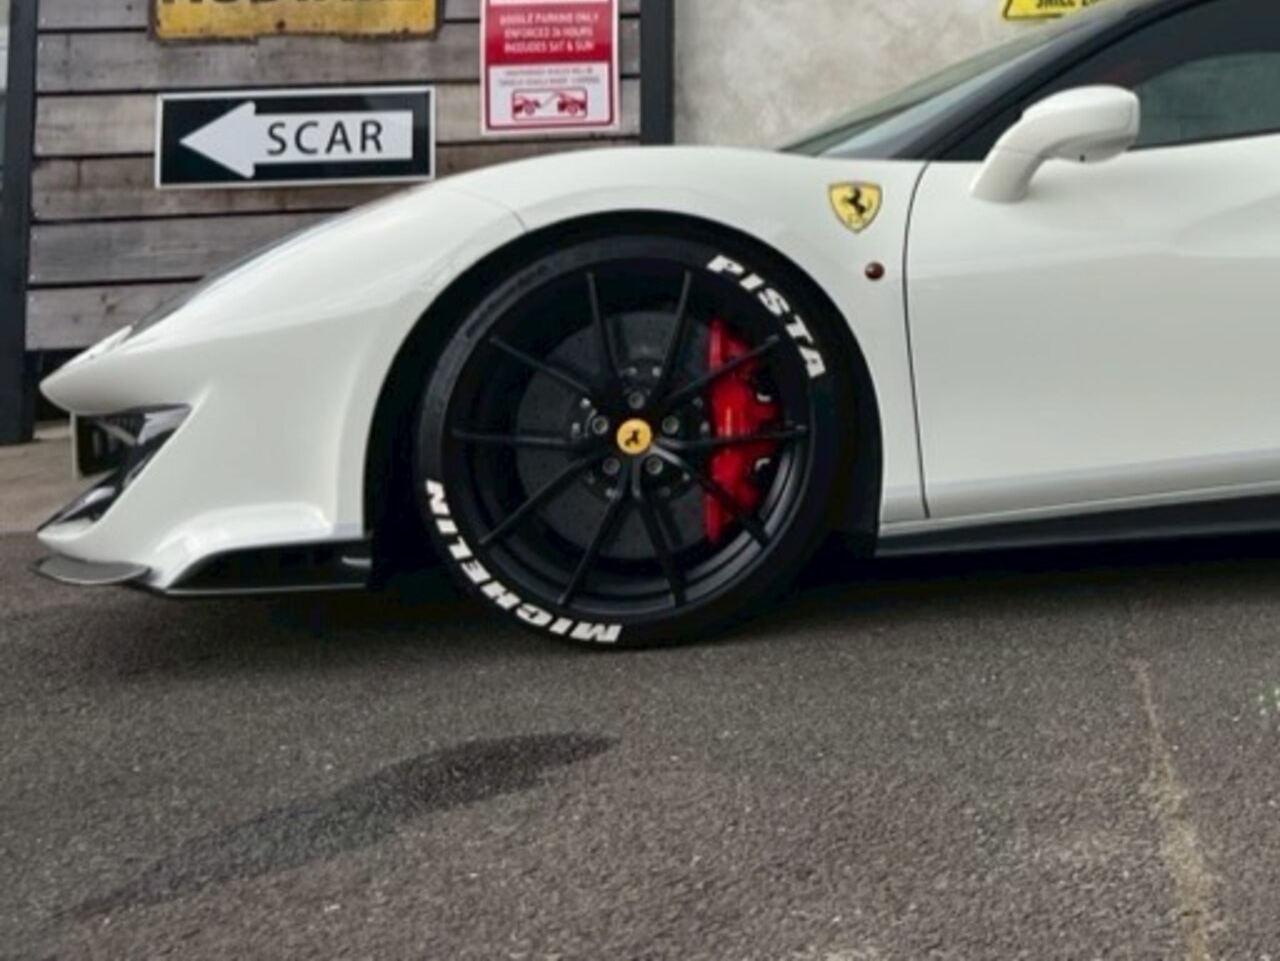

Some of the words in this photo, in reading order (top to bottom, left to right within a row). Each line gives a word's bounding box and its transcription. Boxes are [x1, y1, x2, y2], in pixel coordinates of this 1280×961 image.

[267, 120, 383, 156] SCAR
[707, 254, 827, 379] PISTA
[425, 479, 623, 643] MICHELIN
